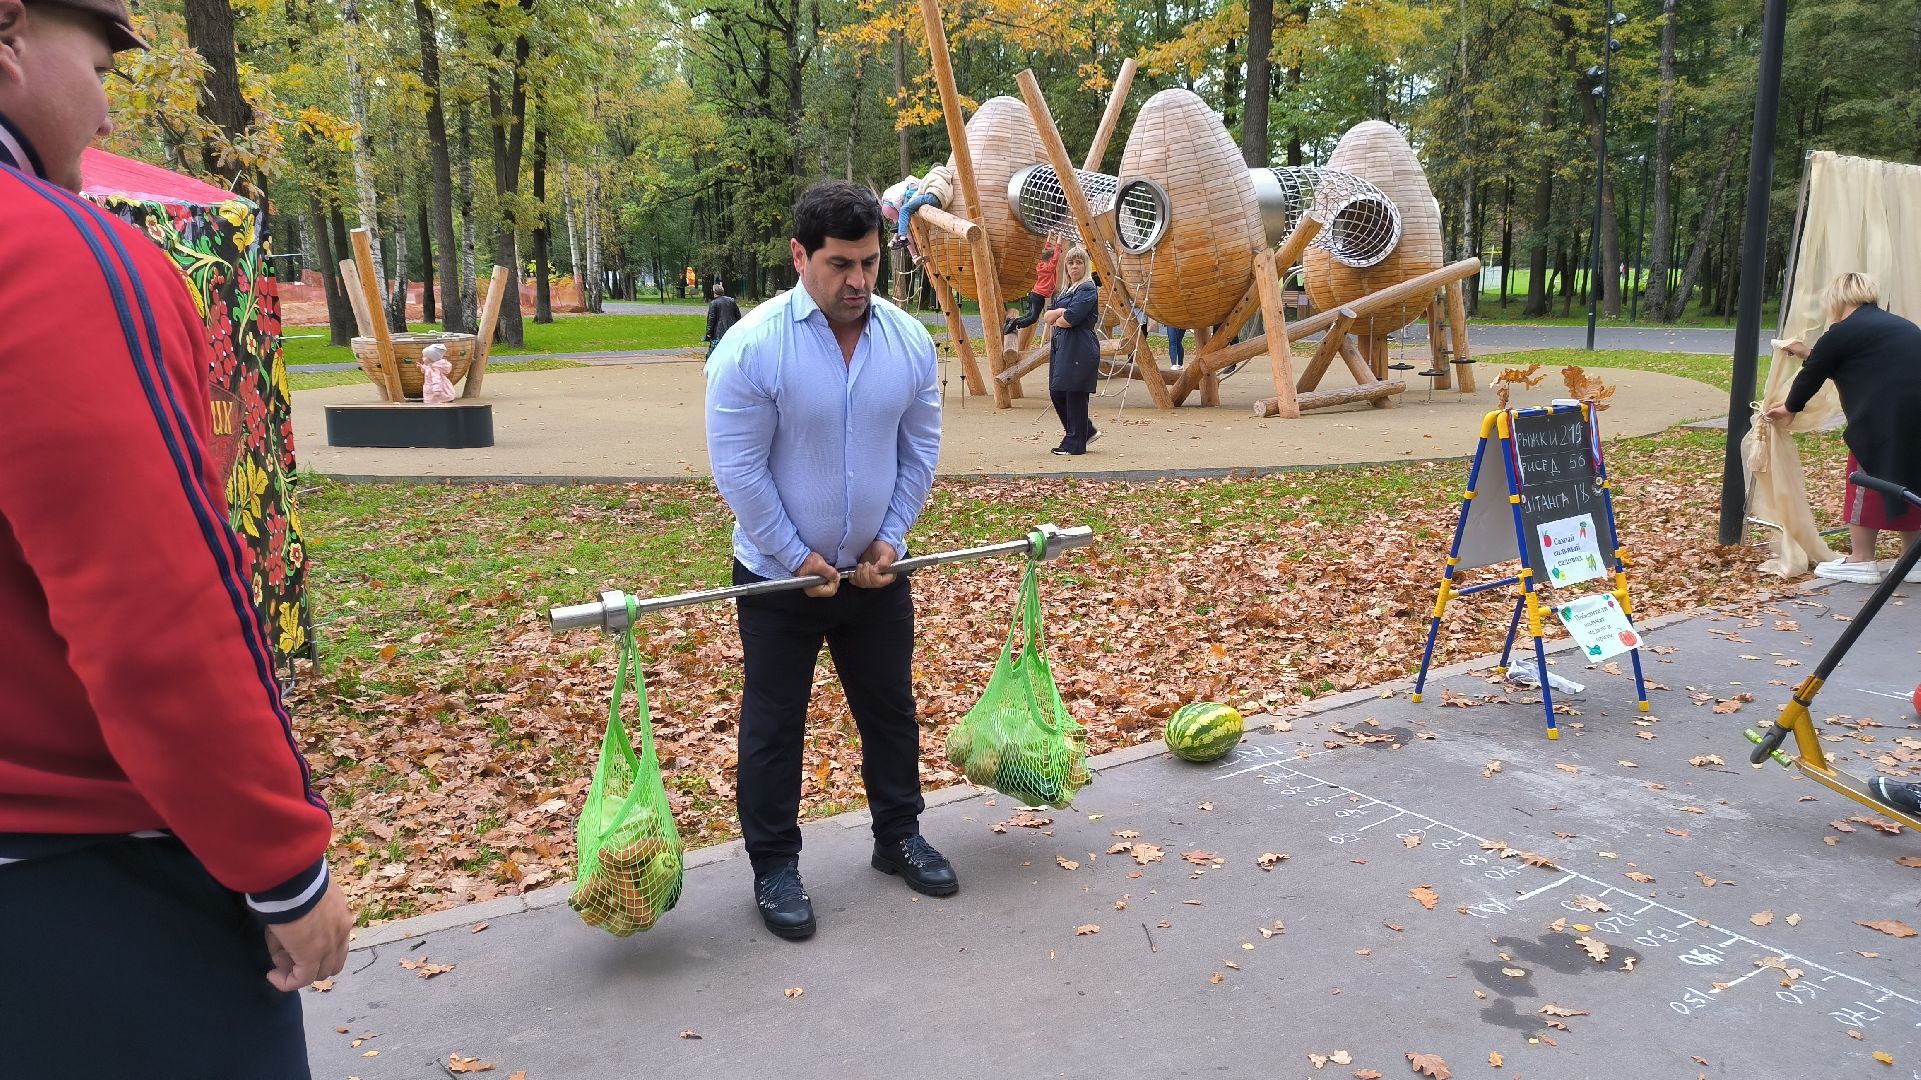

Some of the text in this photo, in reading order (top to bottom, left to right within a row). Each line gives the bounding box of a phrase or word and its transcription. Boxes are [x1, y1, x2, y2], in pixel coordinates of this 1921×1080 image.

[210, 400, 233, 436] ИК
[1517, 430, 1558, 448] РЫЖКИ
[1522, 458, 1561, 476] РИСЕД
[1306, 797, 1330, 808] 30
[1594, 912, 1638, 934] 120
[1633, 926, 1681, 947] 130
[1669, 986, 1716, 1014] 150
[1776, 980, 1827, 1005] 160
